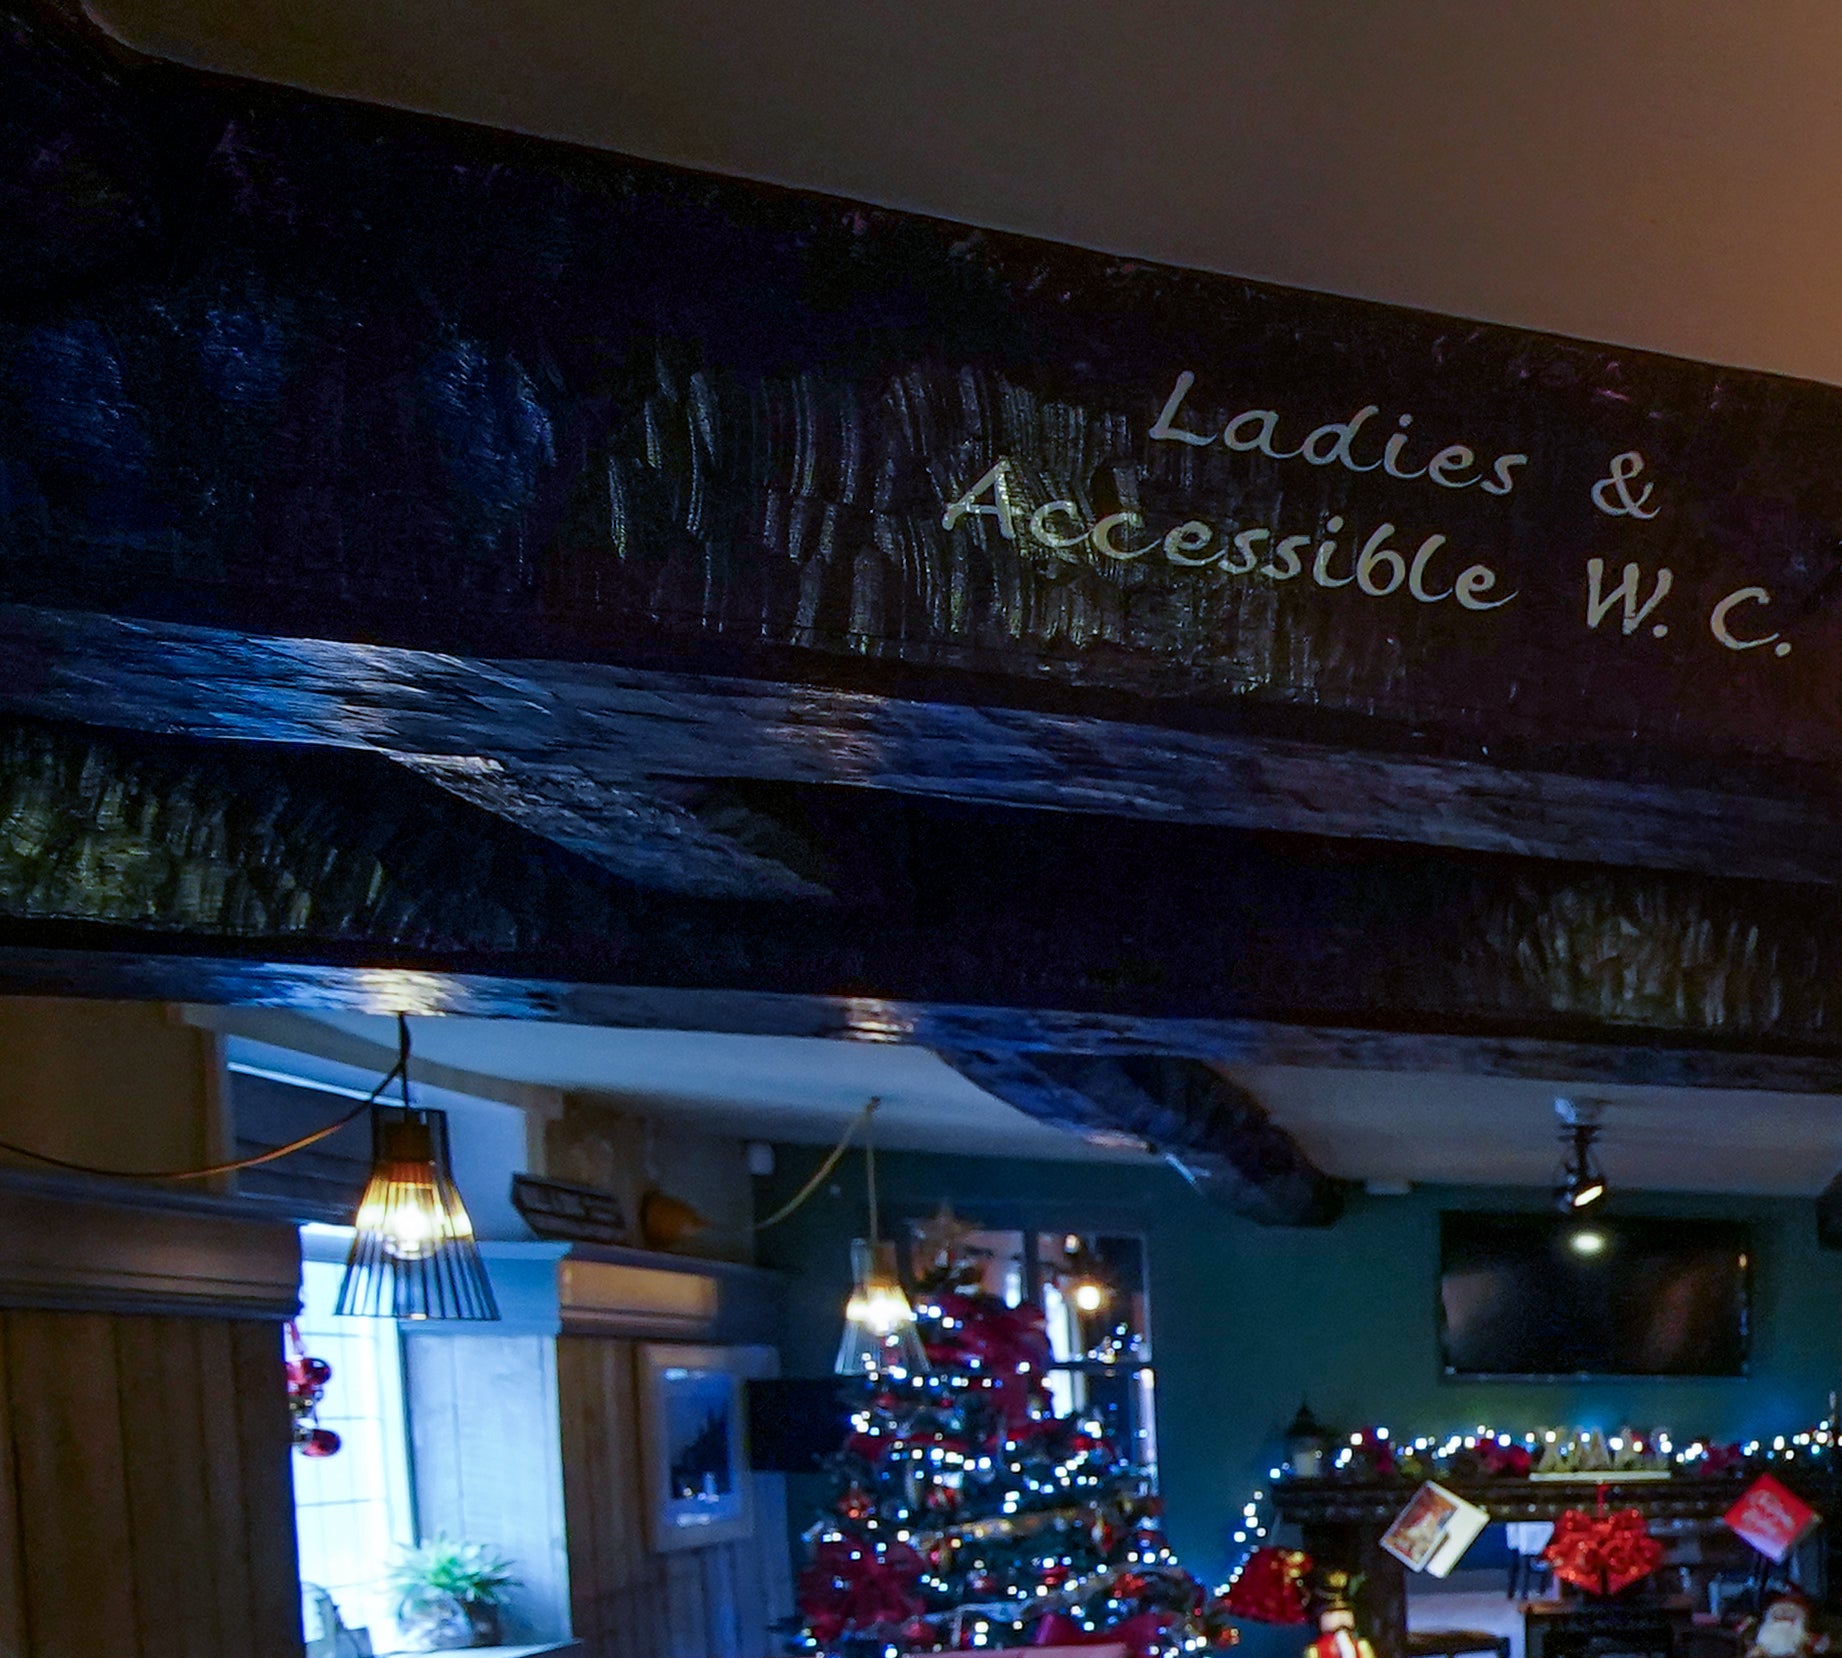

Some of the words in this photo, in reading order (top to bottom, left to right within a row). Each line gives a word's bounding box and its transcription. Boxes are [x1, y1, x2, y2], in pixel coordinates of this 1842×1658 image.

[1148, 371, 1527, 495] Ladies
[1591, 449, 1662, 520] &
[942, 455, 1522, 611] Accessible
[1583, 557, 1670, 640] W.
[1710, 584, 1793, 658] C.
